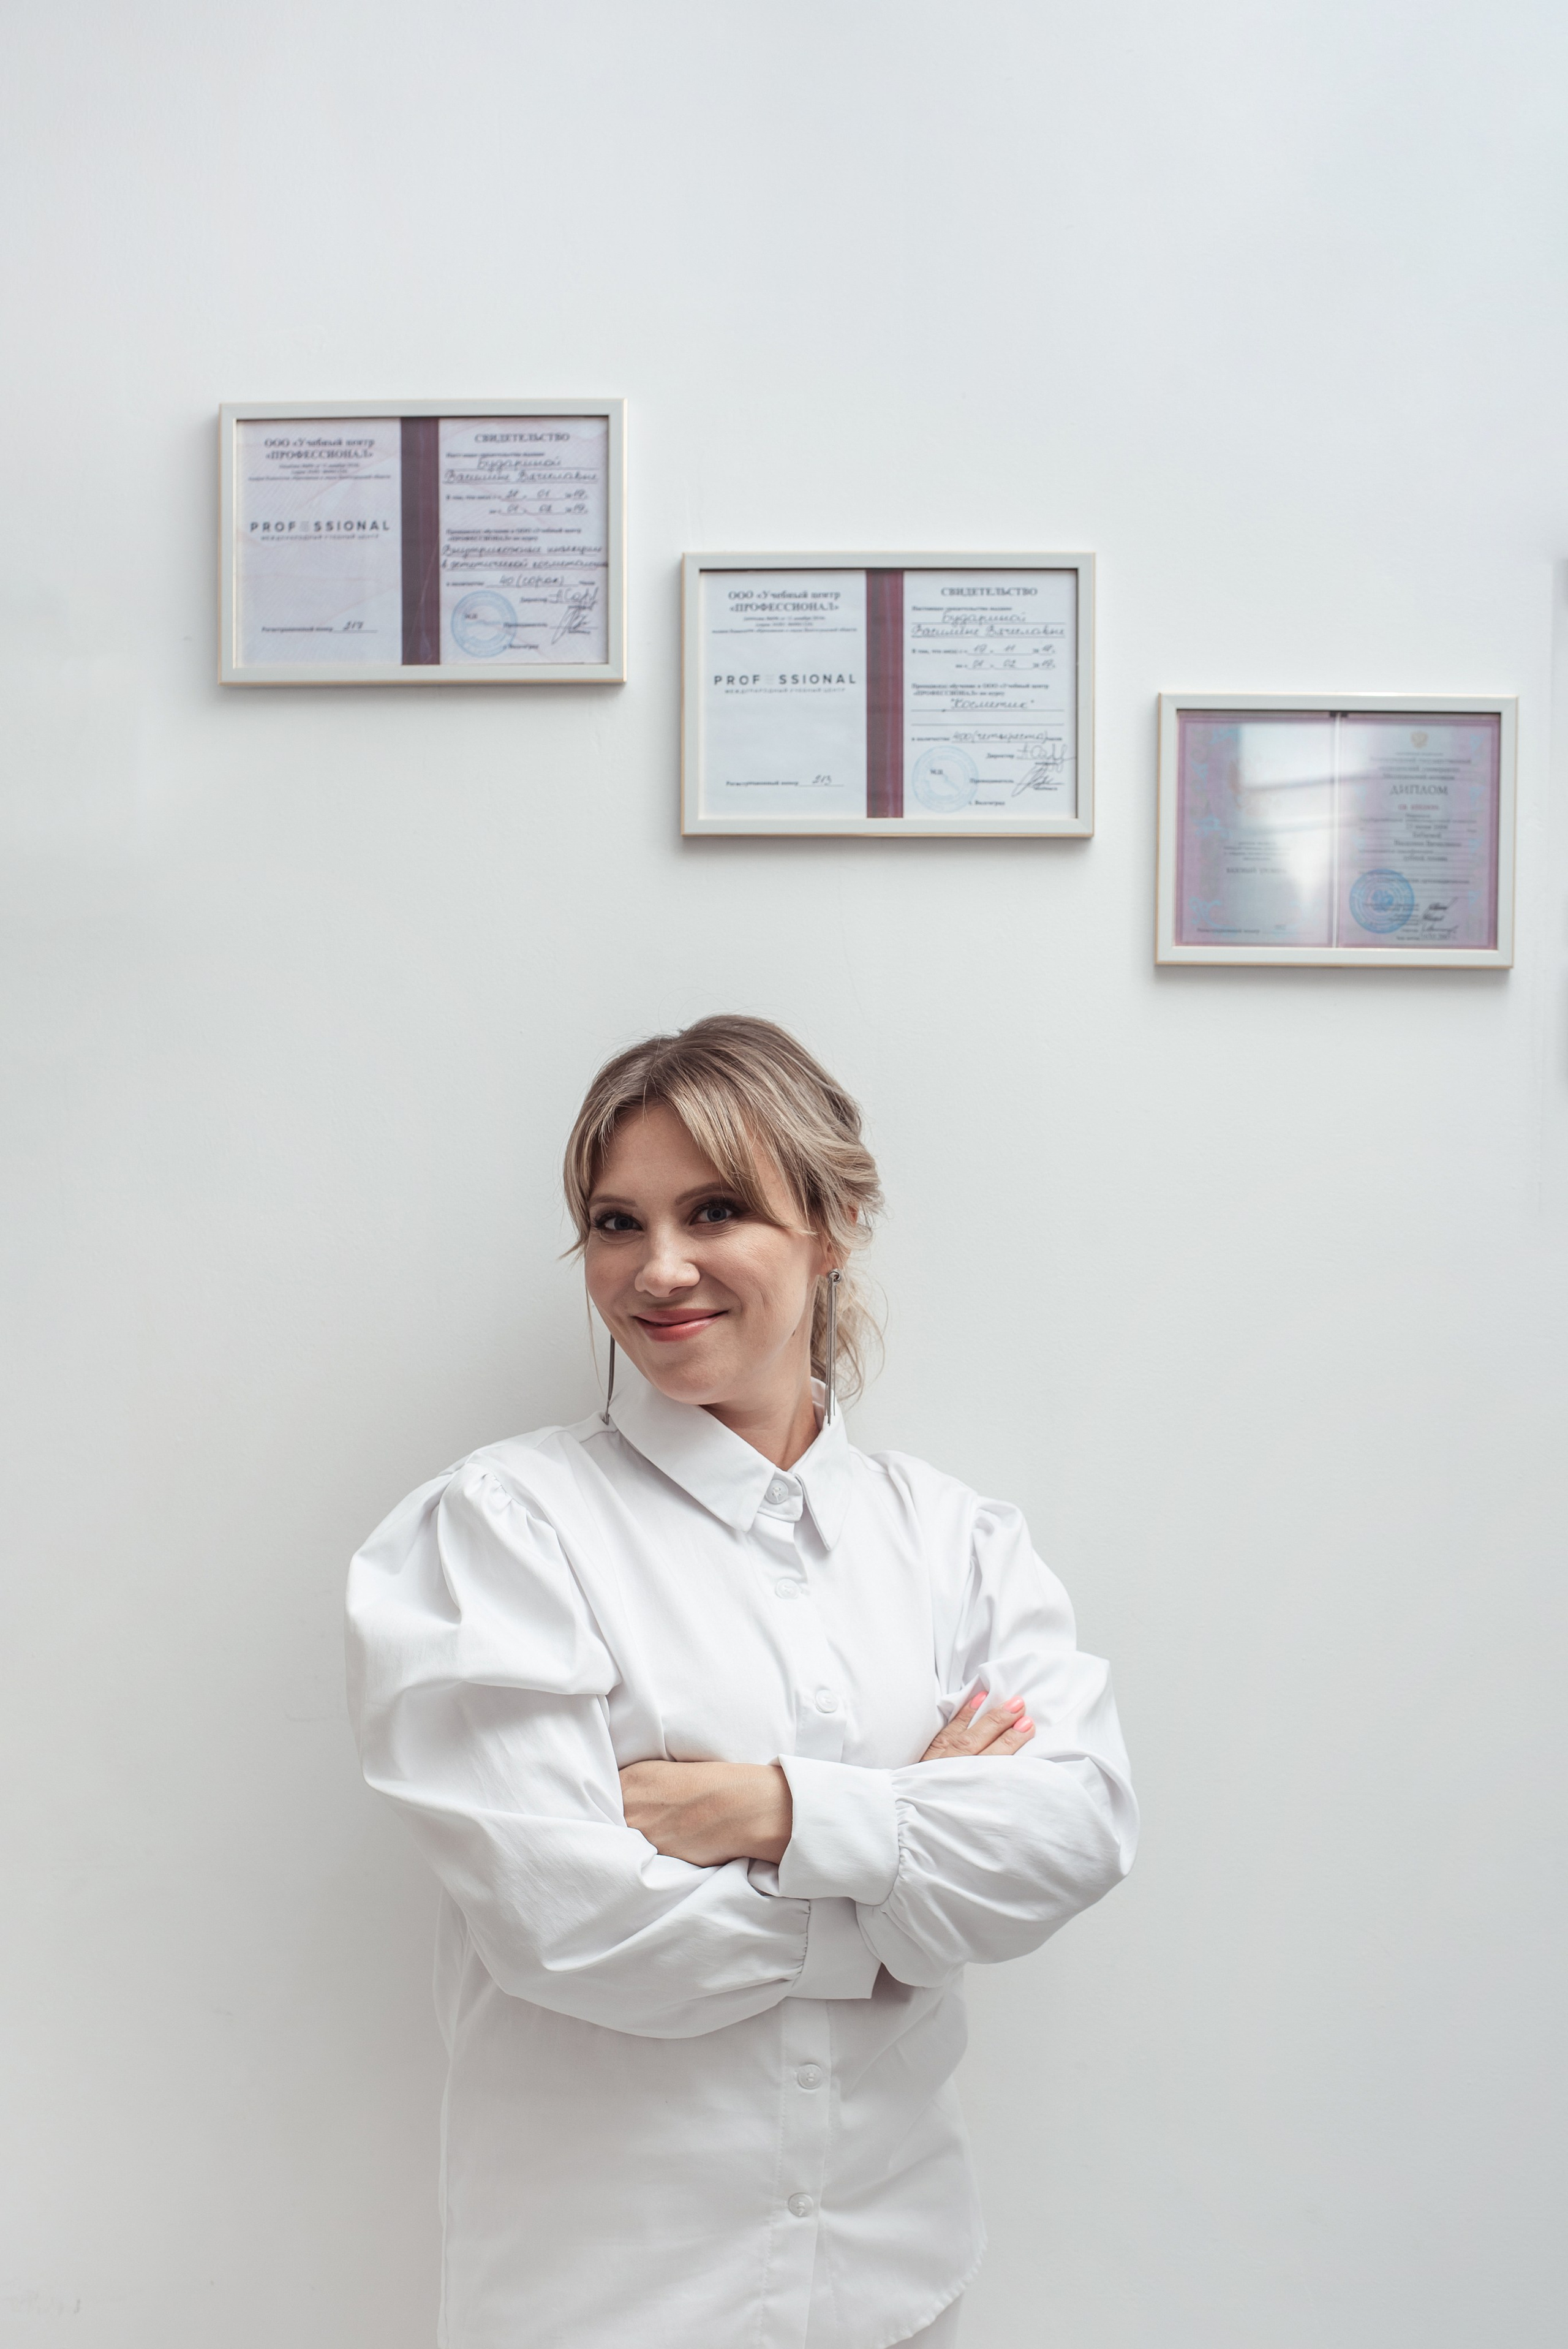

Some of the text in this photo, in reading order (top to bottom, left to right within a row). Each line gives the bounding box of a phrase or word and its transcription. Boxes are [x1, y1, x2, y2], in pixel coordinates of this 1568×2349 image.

[474, 432, 570, 443] СВИДЕТЕЛЬСТВО
[264, 439, 290, 448] ООО
[346, 439, 375, 448] центр
[265, 450, 373, 459] «ПРОФЕССИОНАЛ»
[728, 590, 753, 600] ООО
[811, 591, 840, 600] центр
[941, 587, 1038, 597] СВИДЕТЕЛЬСТВО
[729, 602, 839, 613] «ПРОФЕССИОНАЛ»
[1389, 785, 1449, 796] ДИПЛОМ
